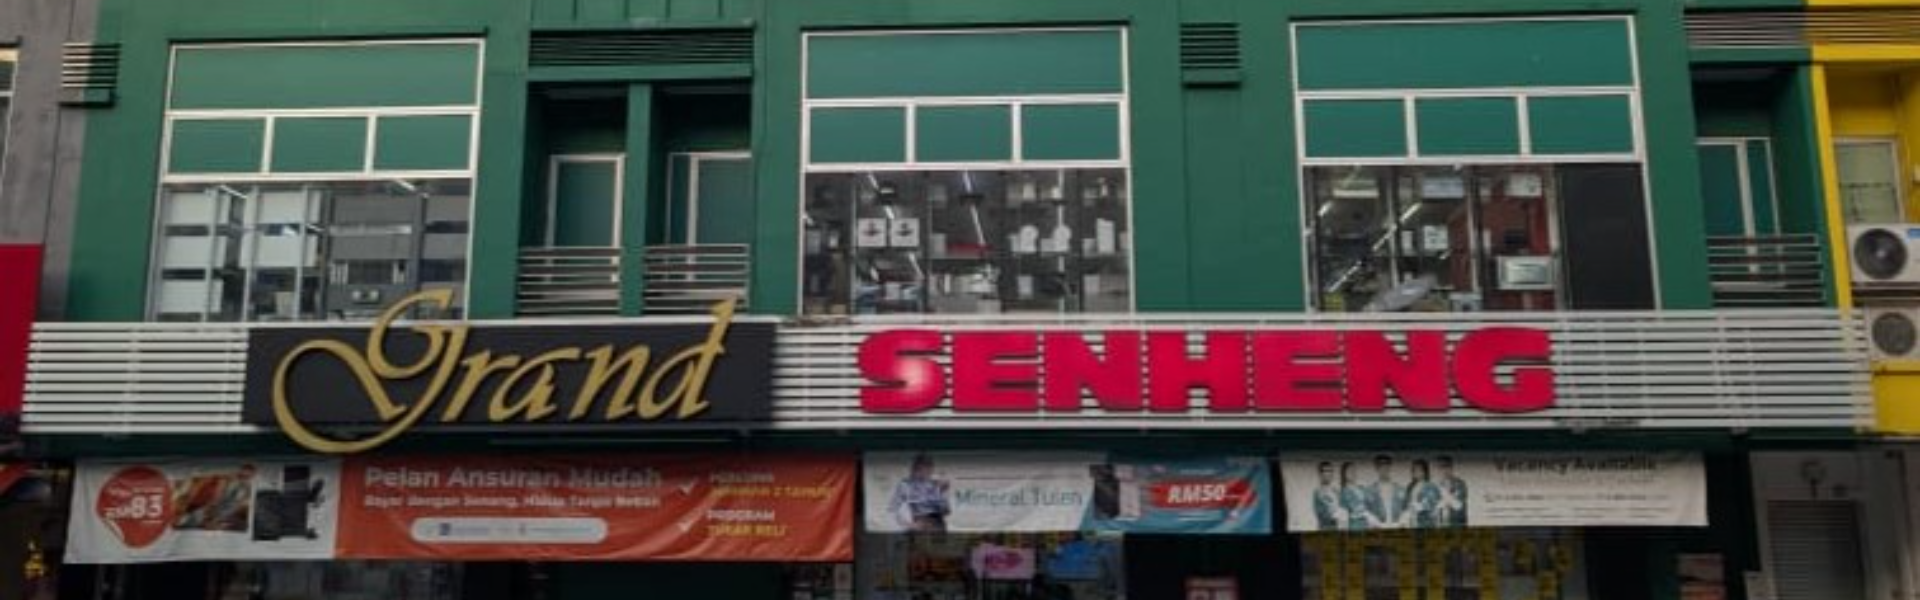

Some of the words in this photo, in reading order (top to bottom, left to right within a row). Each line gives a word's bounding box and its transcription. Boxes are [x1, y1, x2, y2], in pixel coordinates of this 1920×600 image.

[272, 288, 738, 454] Grand
[857, 326, 1557, 414] SENHENG
[364, 467, 439, 488] Pelan
[447, 467, 561, 488] Ansuran
[567, 466, 662, 488] Mudah
[1168, 483, 1227, 504] RM50
